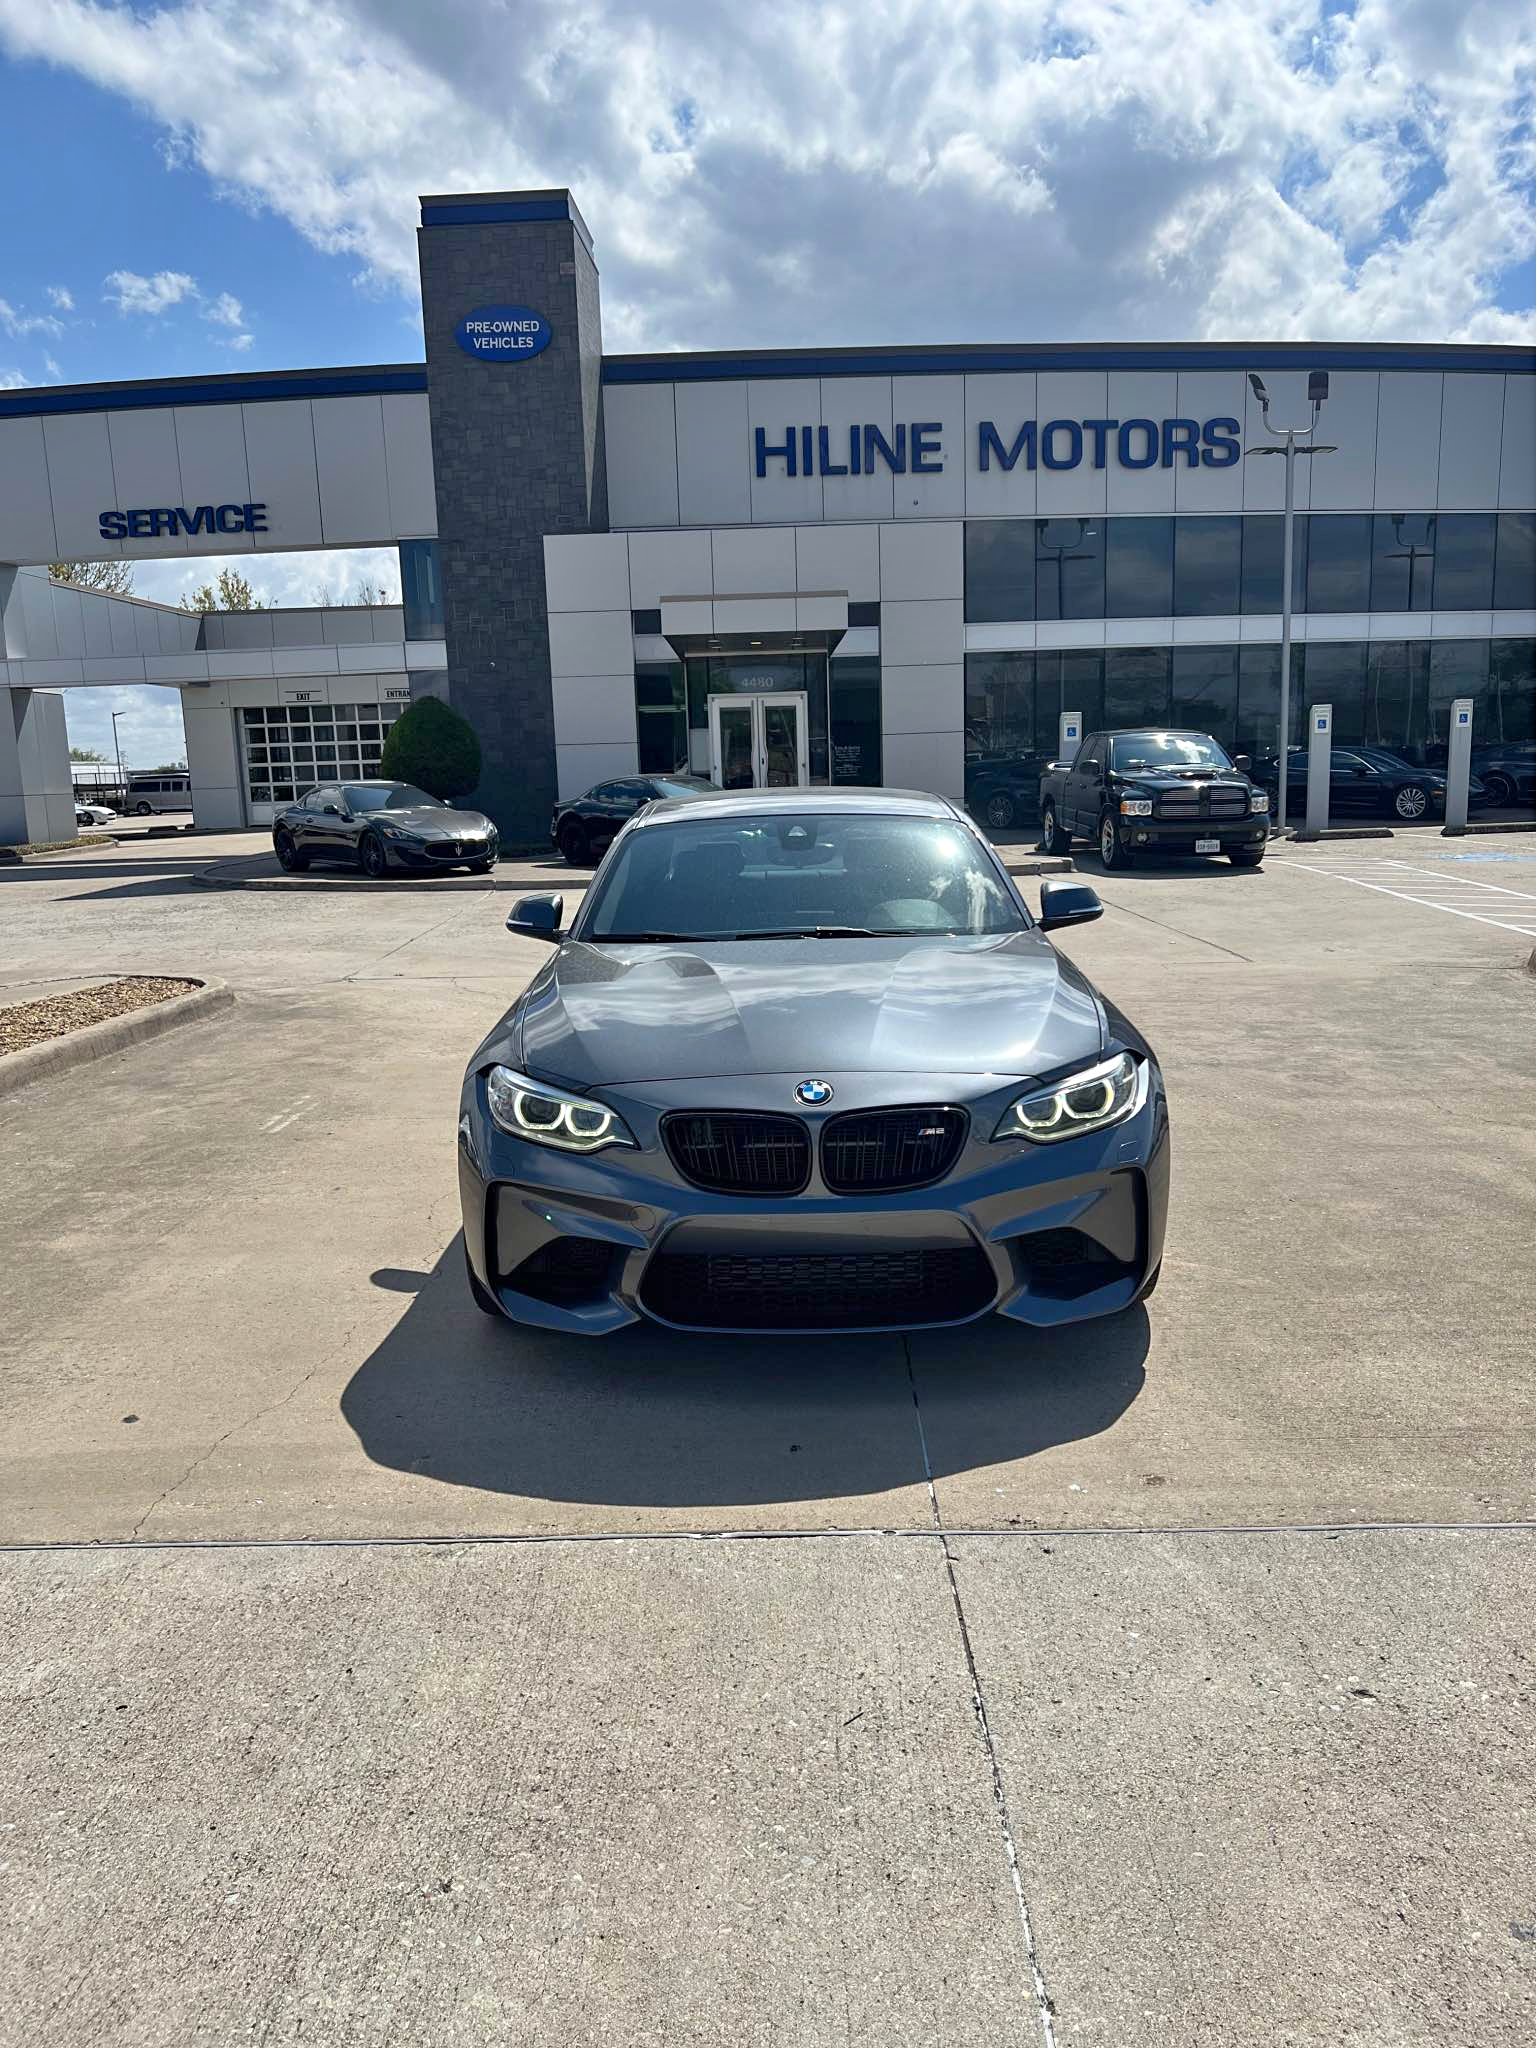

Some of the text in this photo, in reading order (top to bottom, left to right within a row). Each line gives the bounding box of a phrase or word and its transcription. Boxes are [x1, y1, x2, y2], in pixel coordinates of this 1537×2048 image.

[466, 321, 540, 333] PRE-OWNED
[473, 337, 534, 349] VEHICLES
[755, 417, 1241, 477] HILINE MOTORS
[99, 504, 268, 540] SERVICE
[742, 676, 774, 688] 4480
